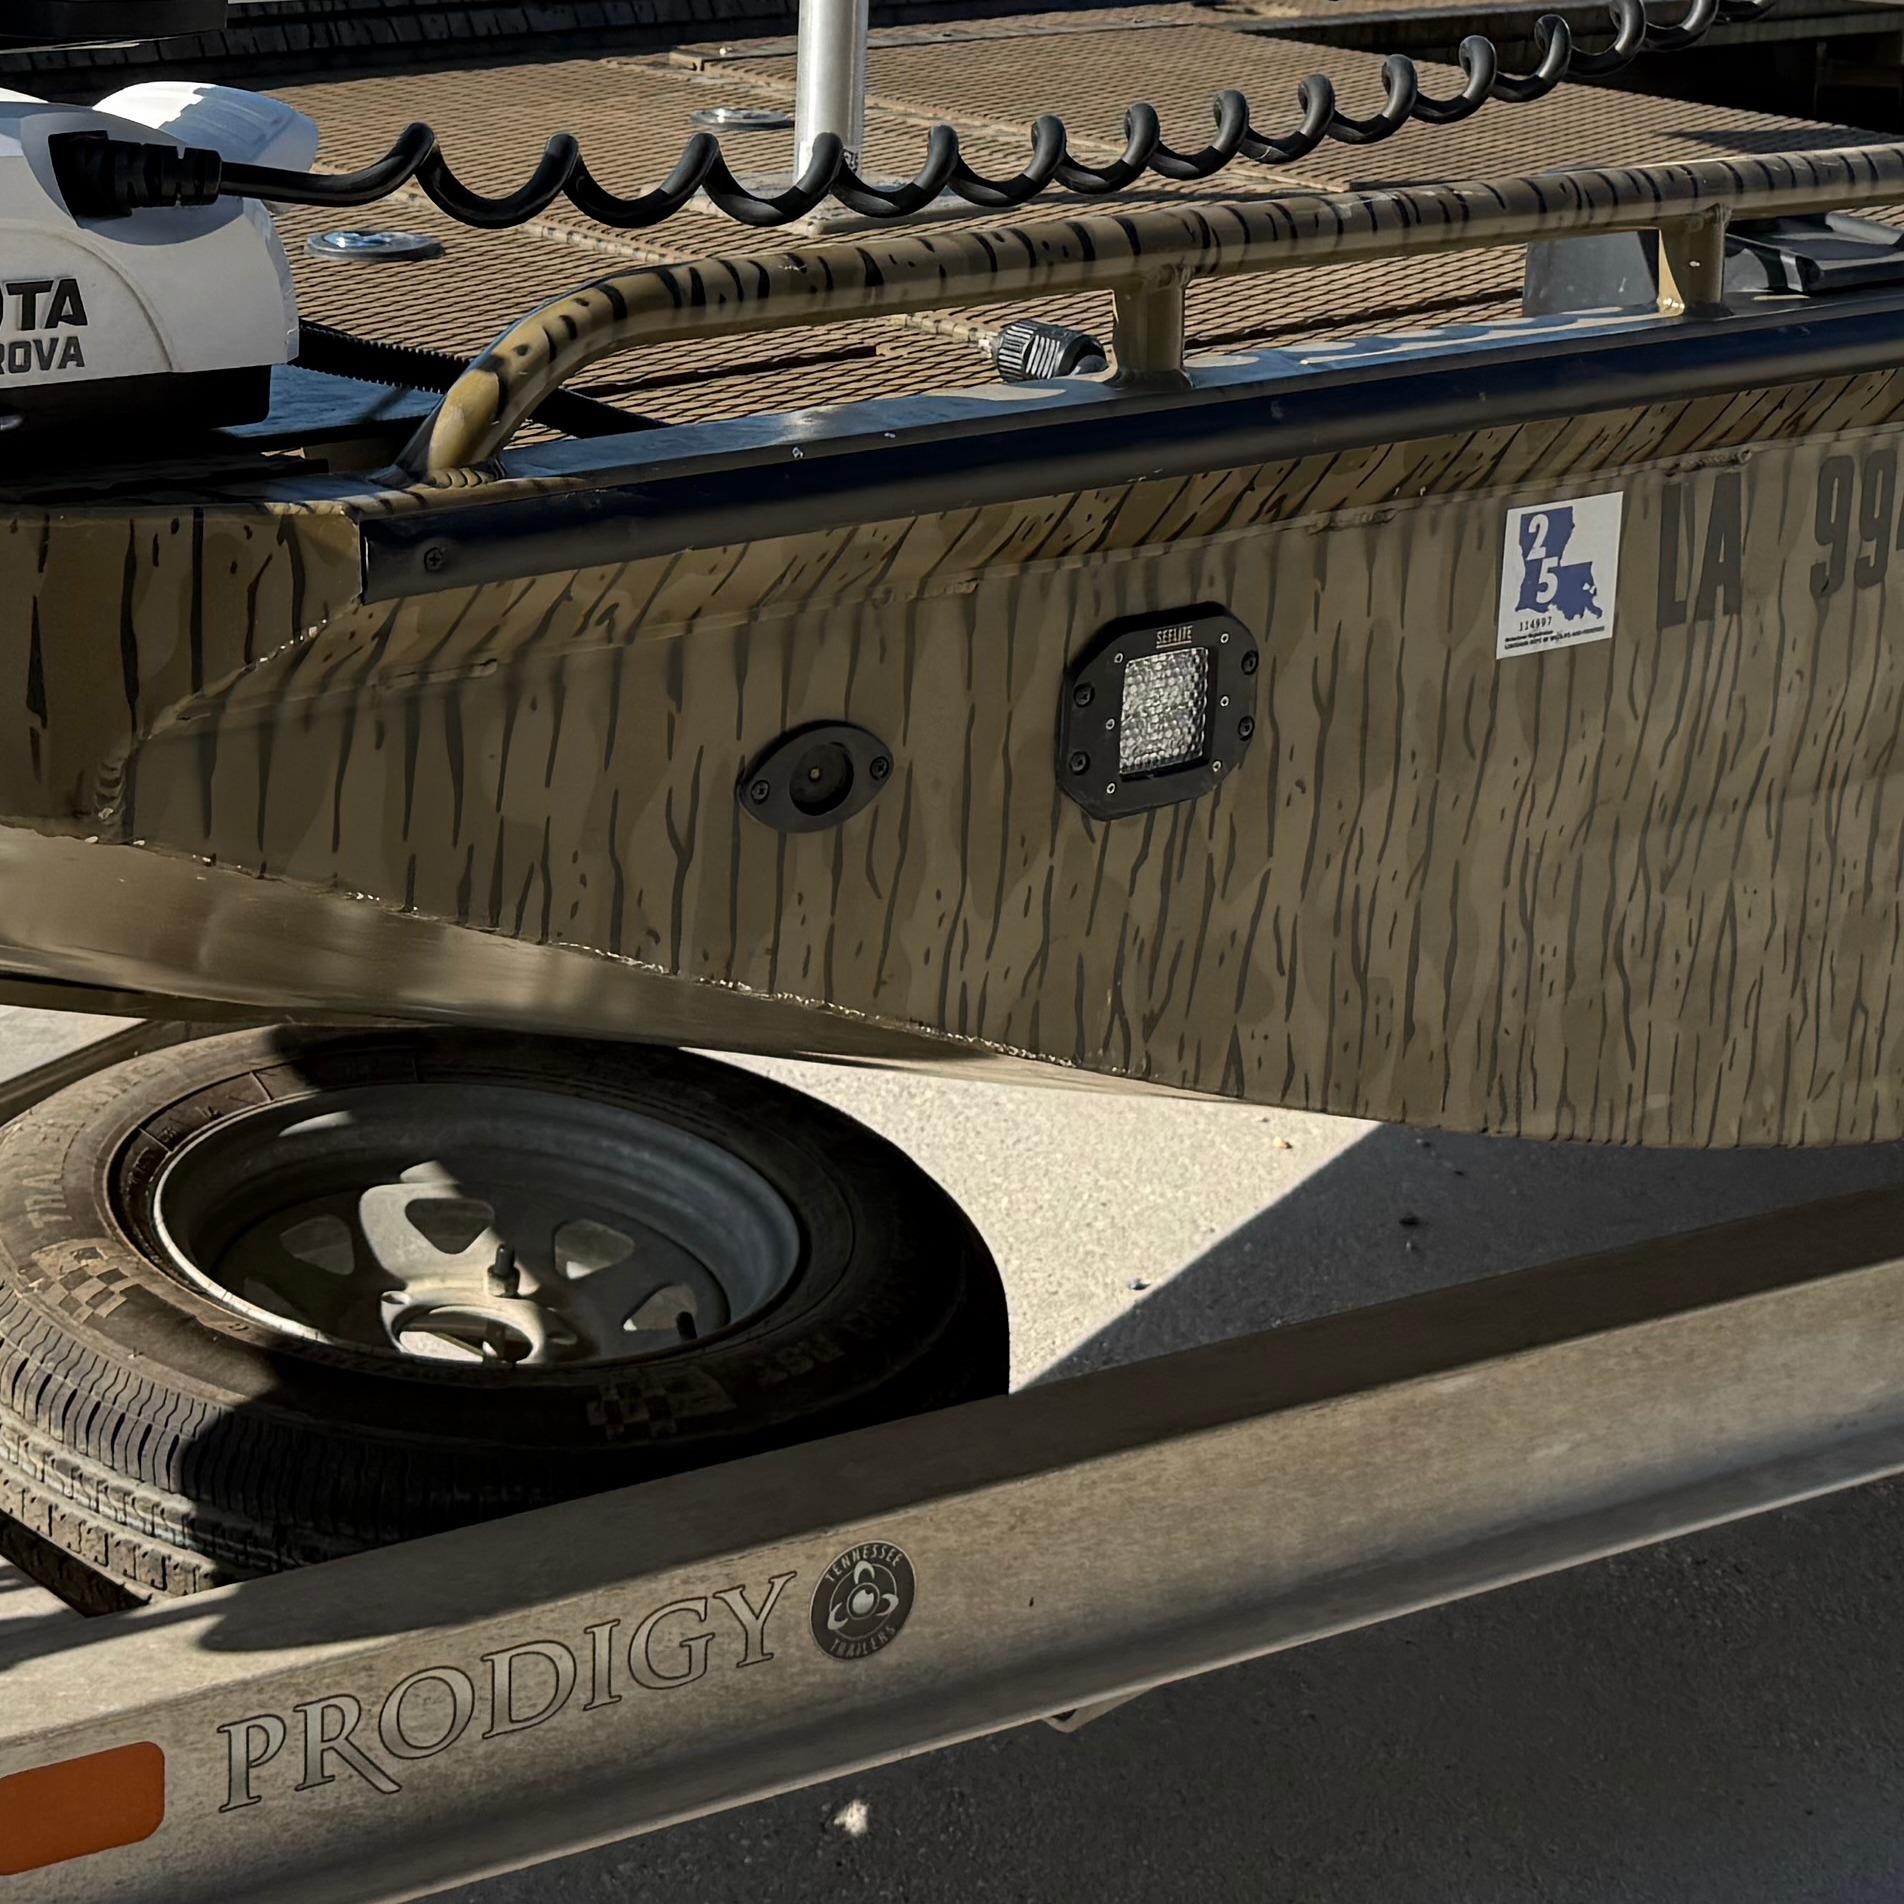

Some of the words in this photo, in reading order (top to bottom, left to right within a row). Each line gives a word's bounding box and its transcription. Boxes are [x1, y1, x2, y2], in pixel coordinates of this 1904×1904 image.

[1657, 473, 1743, 629] LA
[825, 1543, 904, 1582] TENNESSEE
[217, 1570, 796, 1813] PRODIGY
